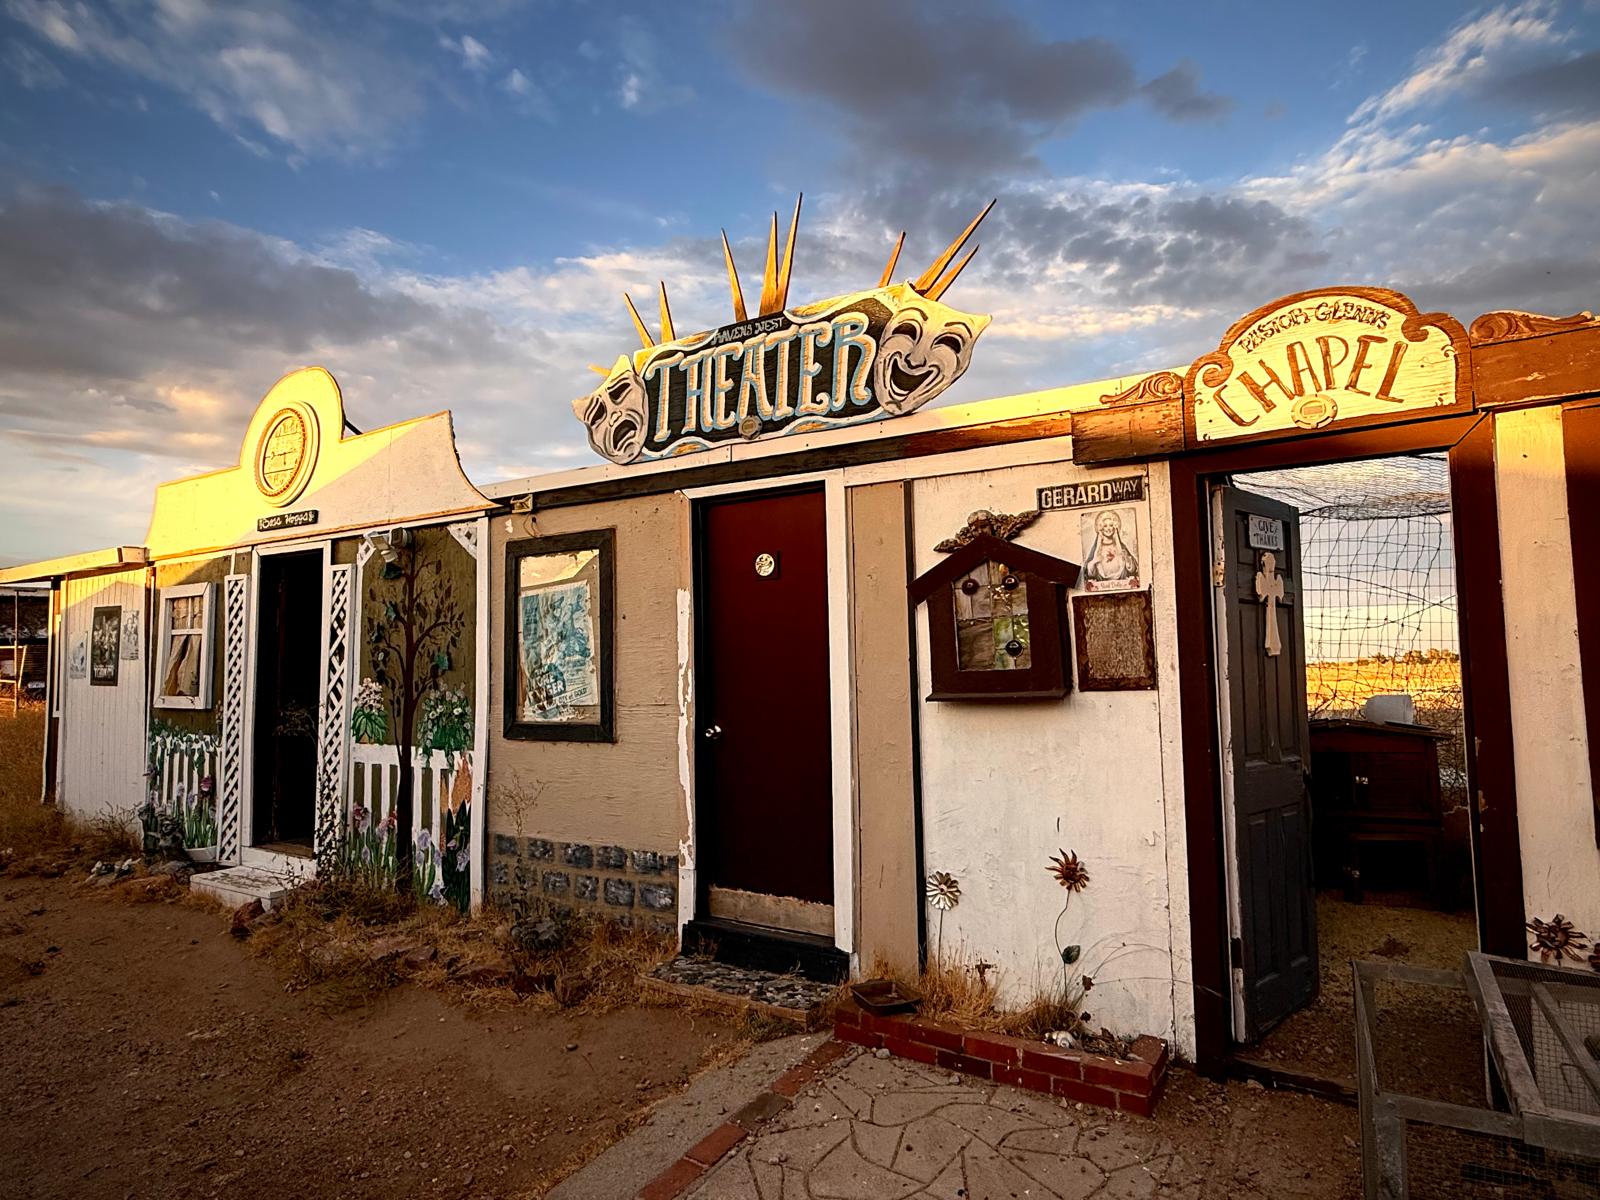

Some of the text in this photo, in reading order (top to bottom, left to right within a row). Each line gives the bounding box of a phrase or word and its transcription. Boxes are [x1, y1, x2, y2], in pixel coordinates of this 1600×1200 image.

[754, 317, 785, 335] NEST
[644, 311, 878, 443] THEATER
[1212, 335, 1408, 427] CHAPEL
[1041, 479, 1138, 509] GERARD WAY
